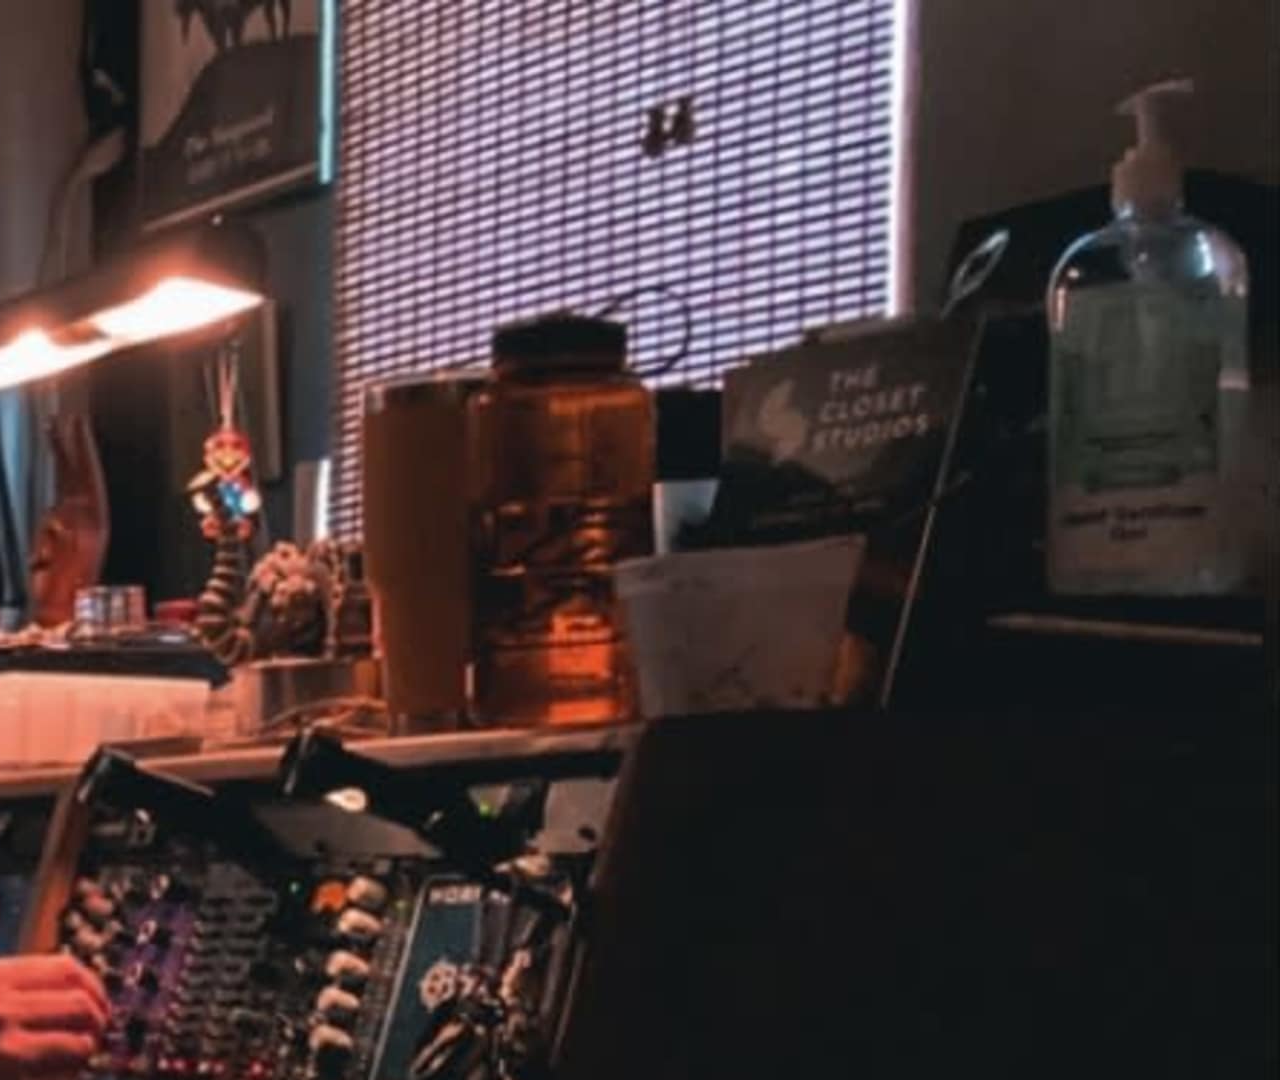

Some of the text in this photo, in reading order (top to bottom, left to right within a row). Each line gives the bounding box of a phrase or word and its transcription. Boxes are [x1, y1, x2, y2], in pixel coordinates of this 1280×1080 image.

[830, 363, 878, 392] THE
[819, 383, 927, 423] CLOSET
[811, 412, 929, 452] STUDIOS
